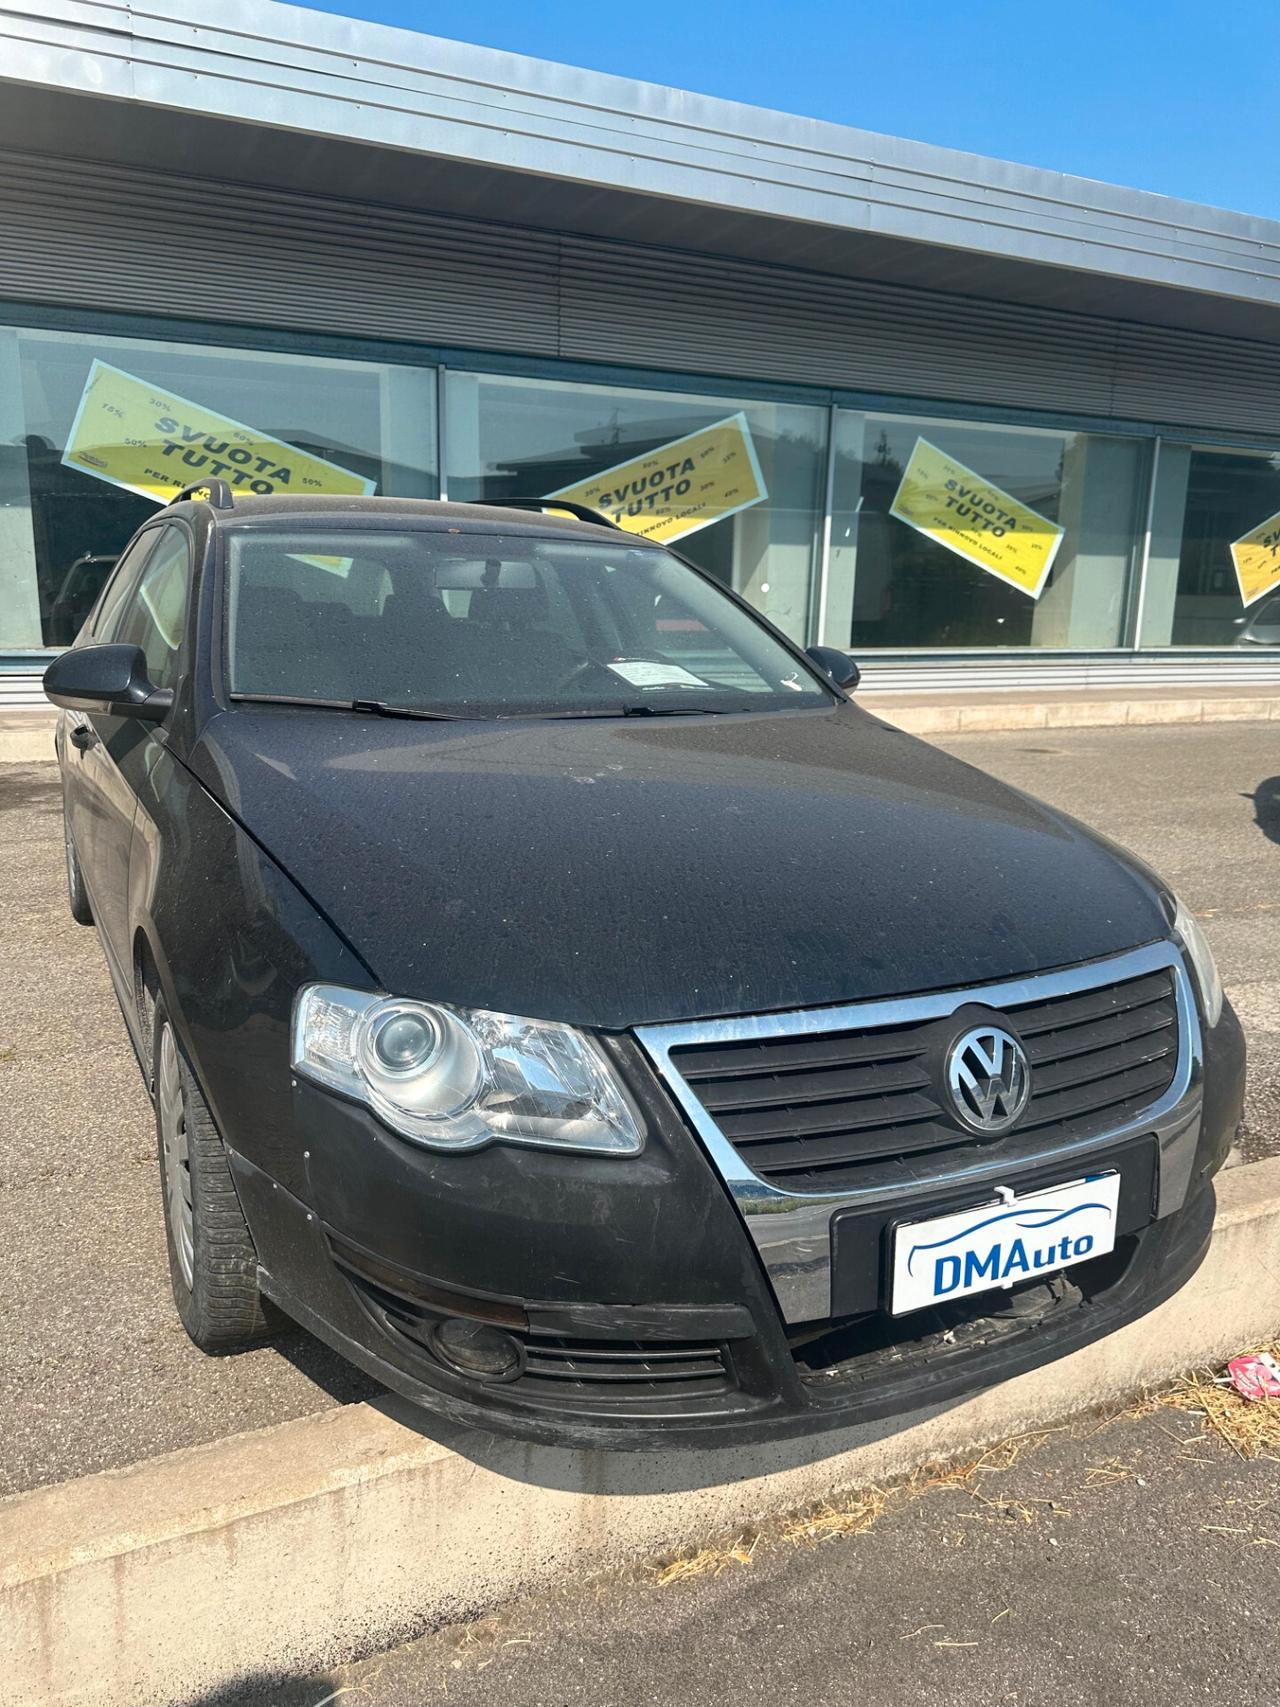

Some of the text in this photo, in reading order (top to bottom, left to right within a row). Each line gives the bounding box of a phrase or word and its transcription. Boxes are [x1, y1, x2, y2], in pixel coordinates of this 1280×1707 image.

[143, 467, 169, 483] PER
[154, 416, 291, 485] SVUOTA
[161, 439, 275, 495] TUTTO
[597, 457, 696, 510] SVUOTA
[612, 479, 691, 524] TUTTO
[944, 478, 1018, 530] SVUOTA
[944, 495, 1006, 539] TUTTO
[933, 1233, 1094, 1297] DMAuto
